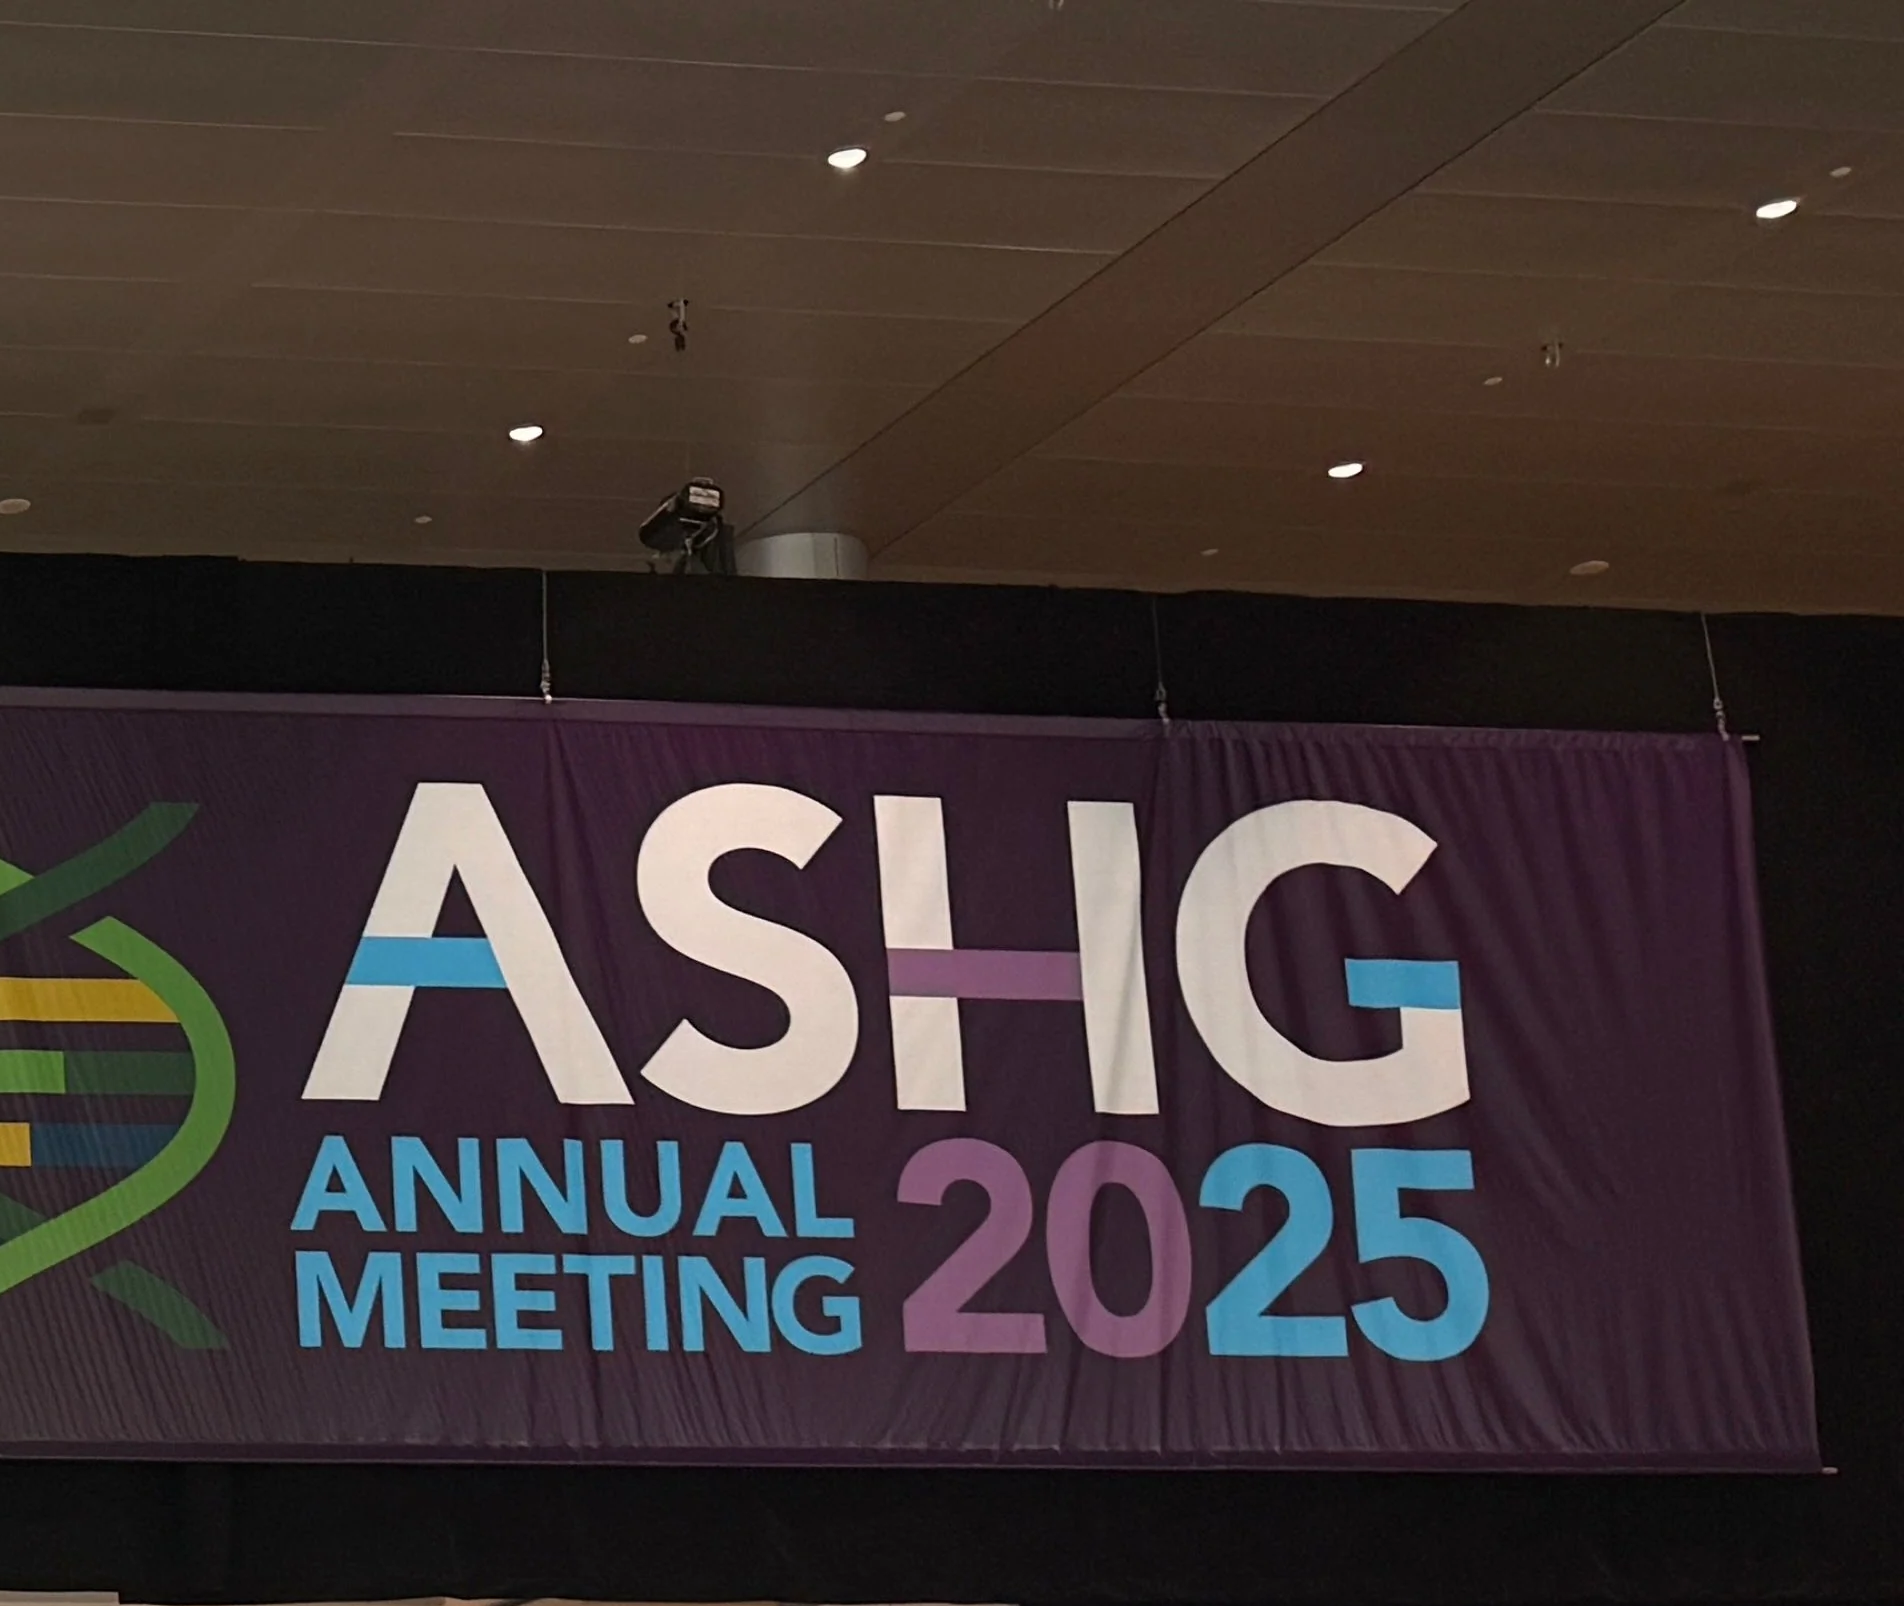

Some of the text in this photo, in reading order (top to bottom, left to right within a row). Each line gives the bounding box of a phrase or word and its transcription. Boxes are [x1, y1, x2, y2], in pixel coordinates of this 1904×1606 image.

[301, 782, 1470, 1127] ASHG
[291, 1134, 1490, 1362] ANNUAL 2025
[294, 1249, 862, 1354] MEETING
